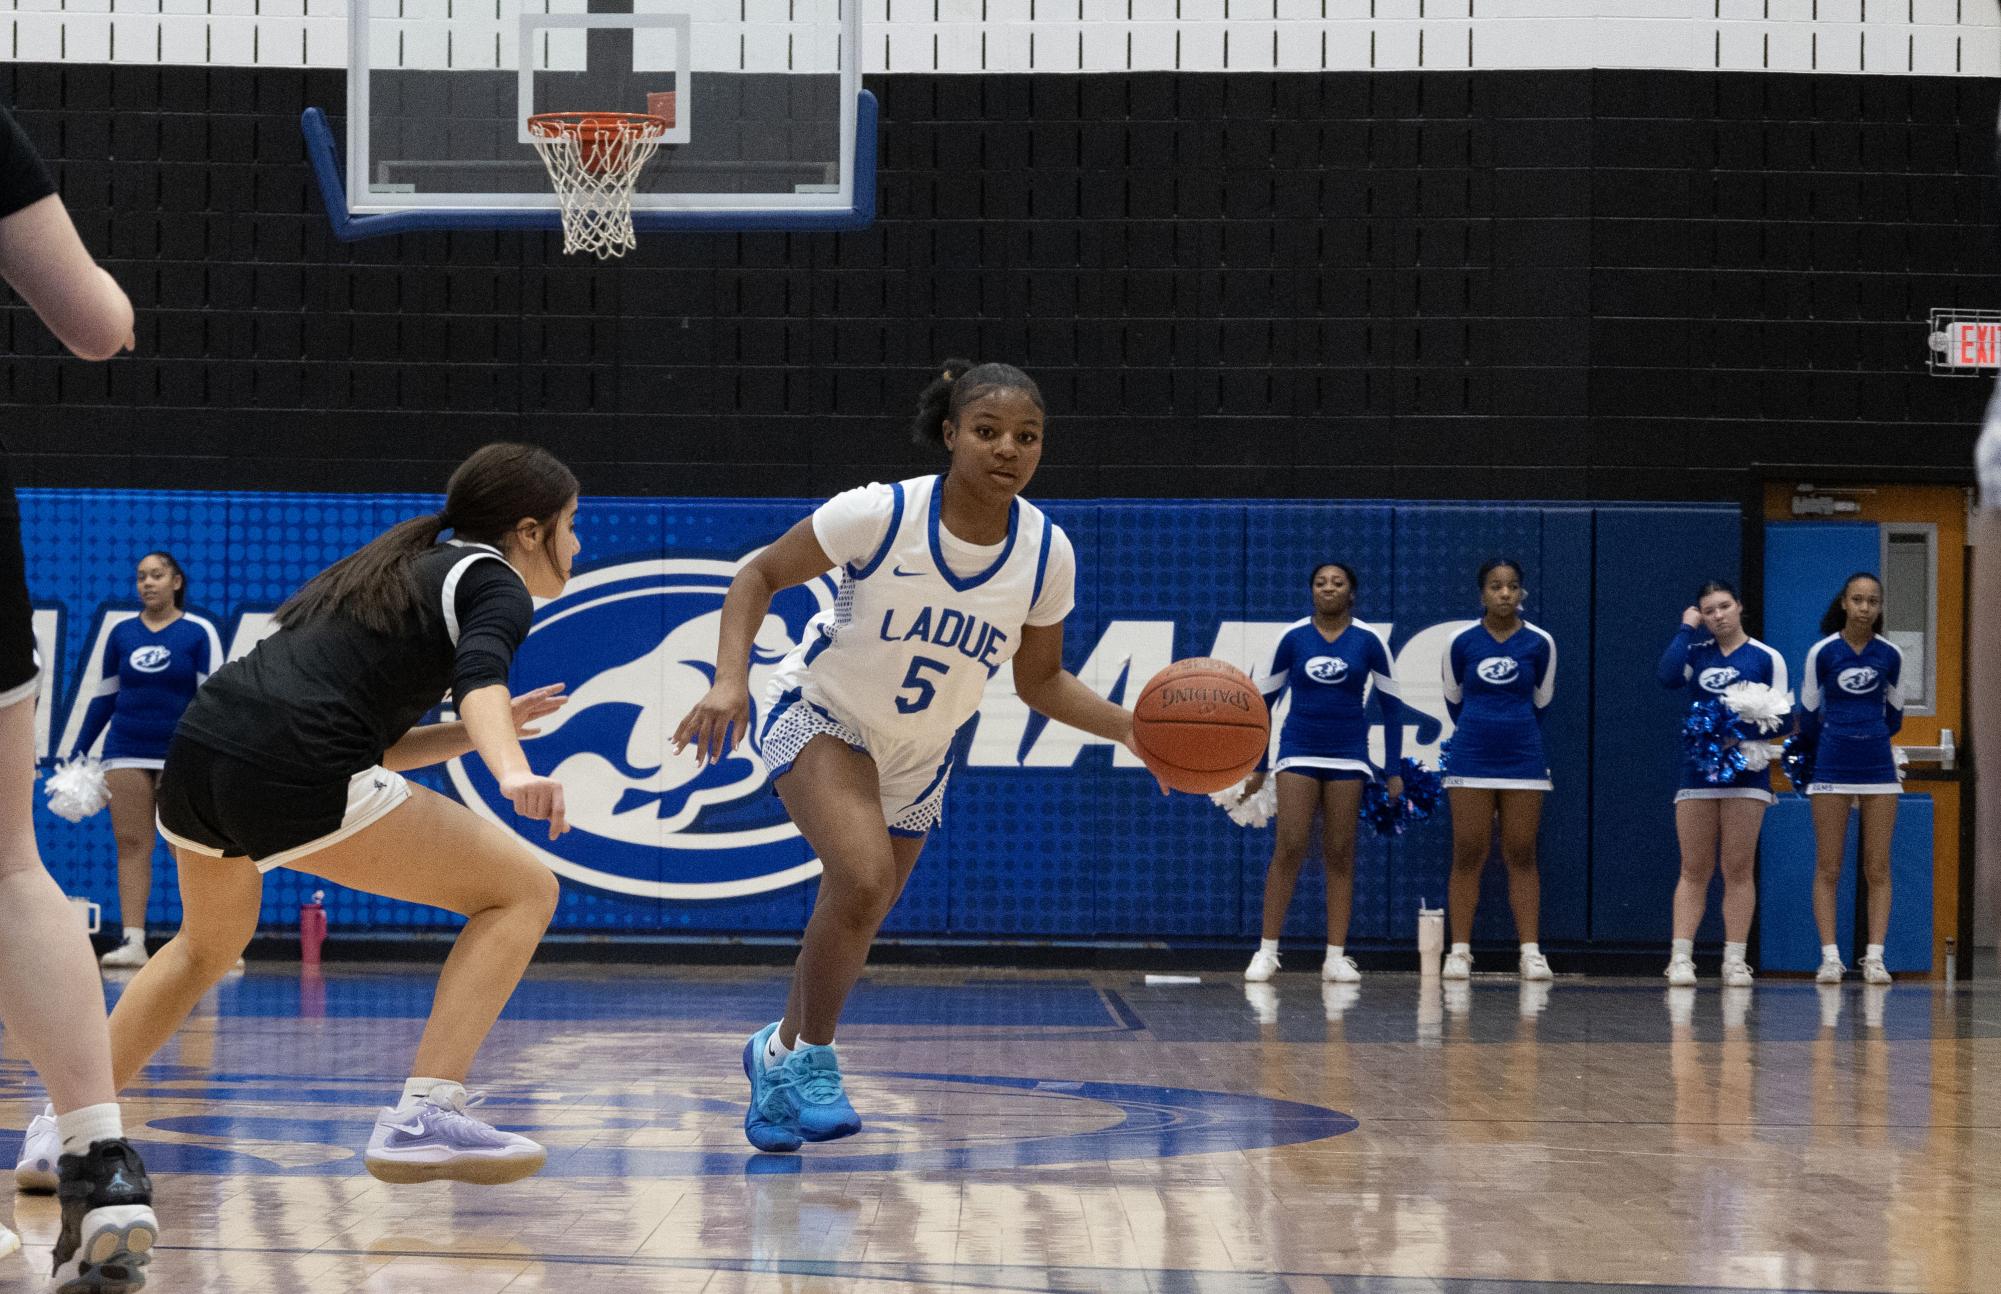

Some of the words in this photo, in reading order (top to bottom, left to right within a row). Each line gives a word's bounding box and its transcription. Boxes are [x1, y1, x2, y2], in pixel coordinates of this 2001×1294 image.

[1961, 325, 2001, 364] EXI
[879, 606, 1007, 669] LADUE
[895, 655, 950, 714] 5
[1161, 687, 1250, 712] SPALDING
